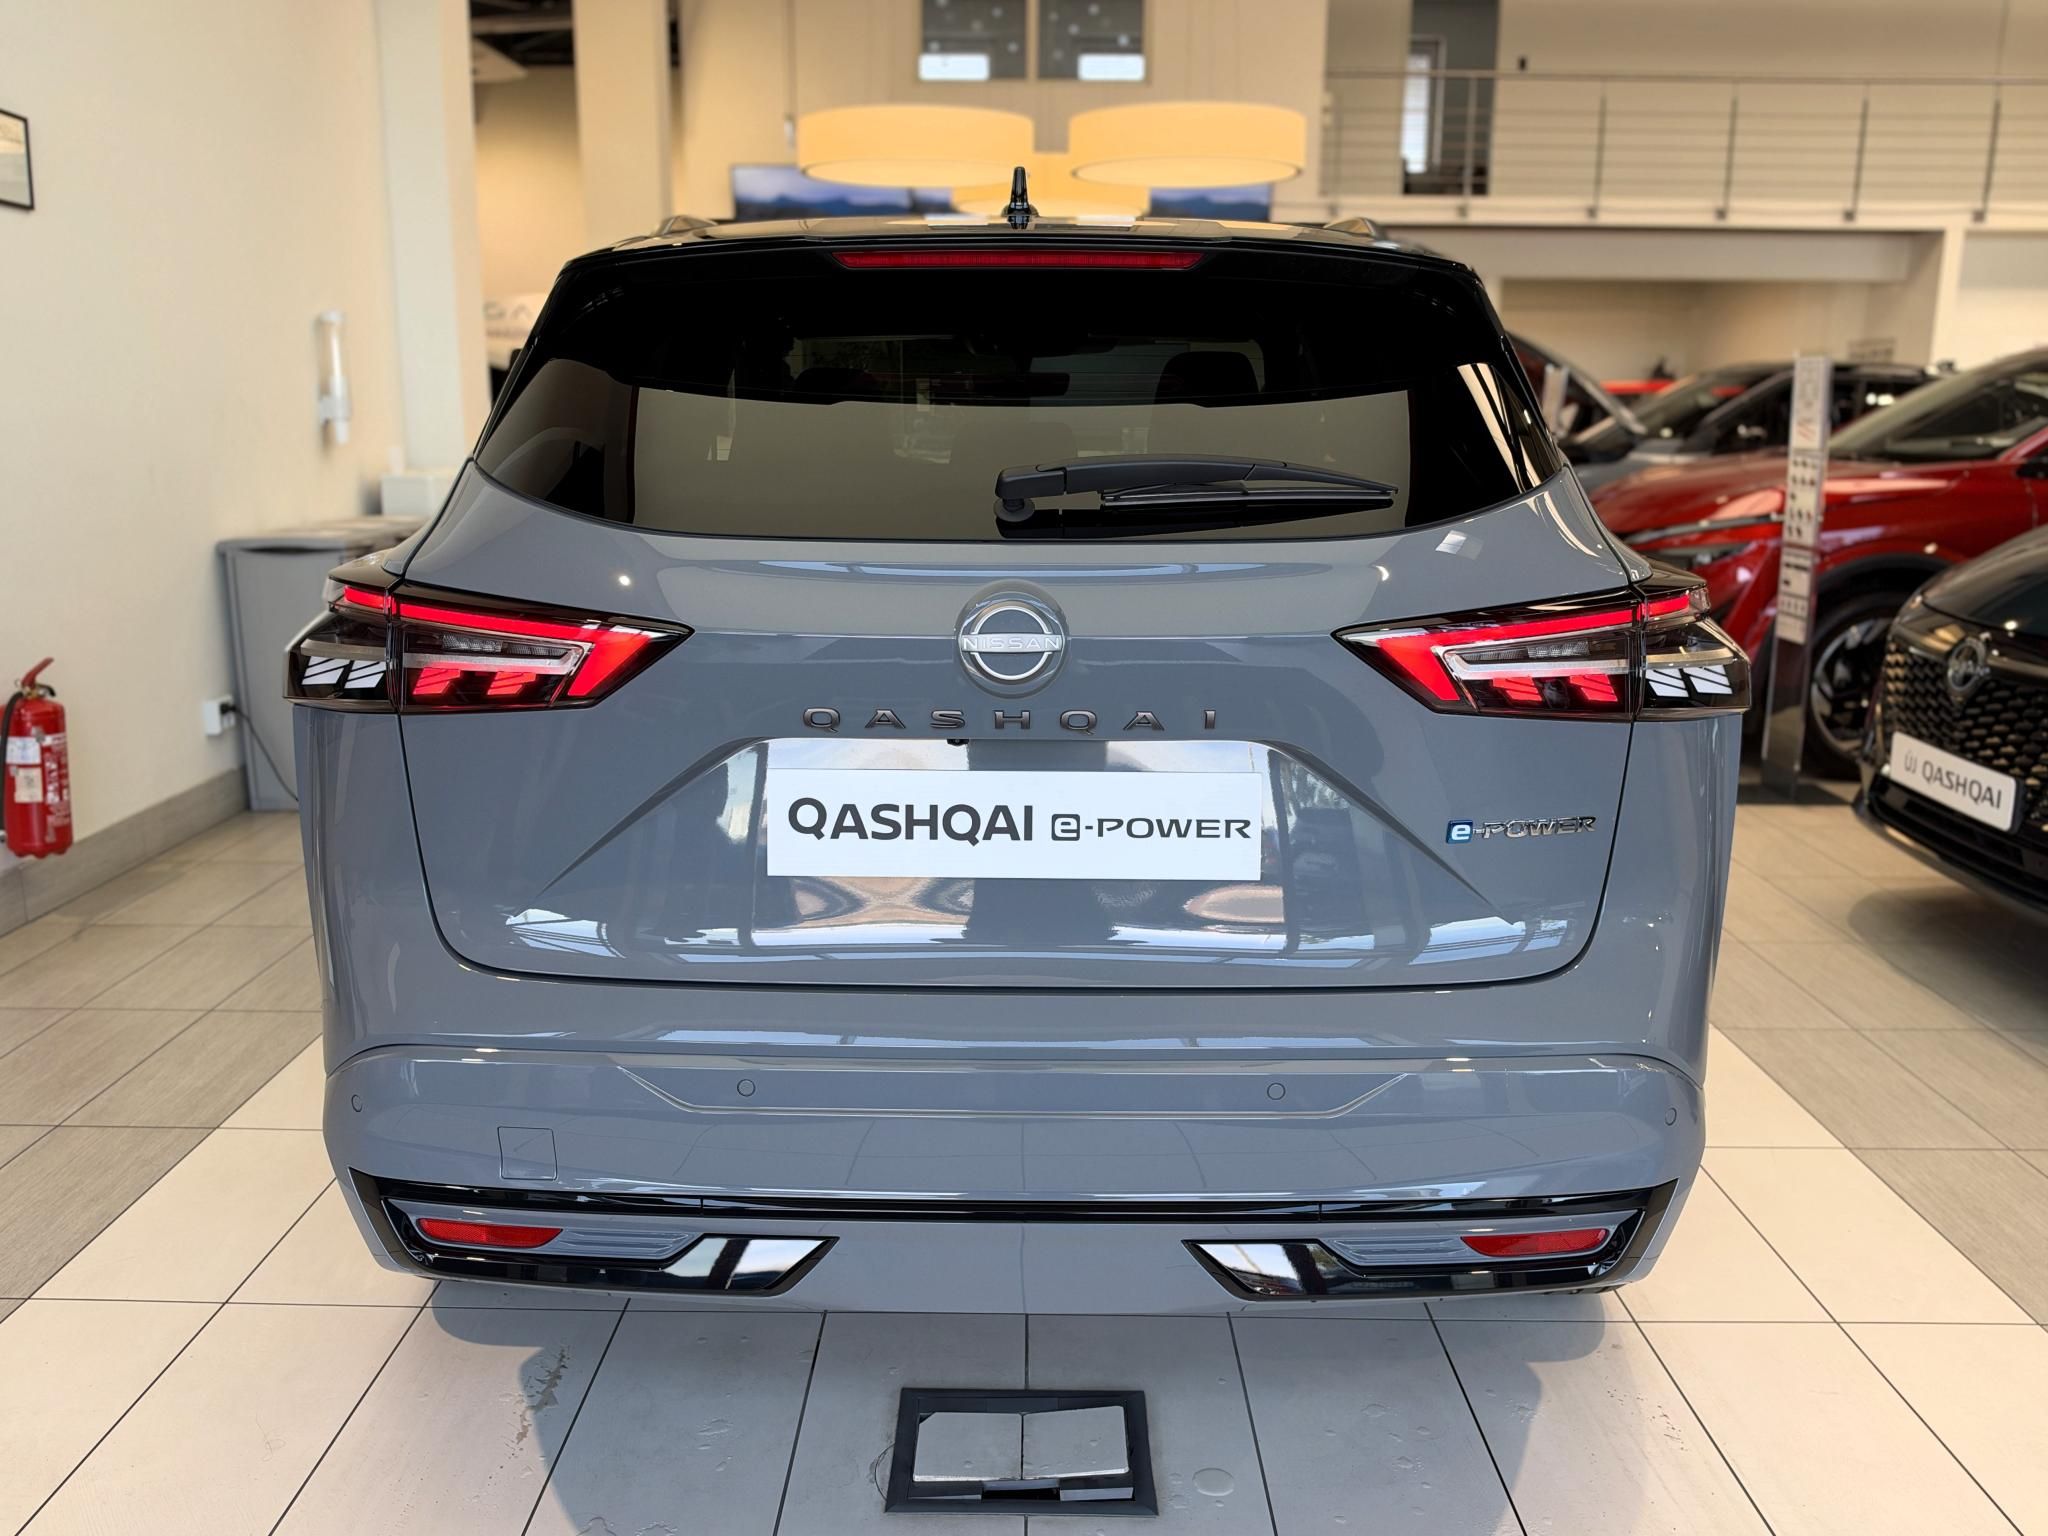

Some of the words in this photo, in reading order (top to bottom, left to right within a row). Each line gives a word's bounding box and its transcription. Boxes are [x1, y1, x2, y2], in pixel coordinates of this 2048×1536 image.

[962, 637, 1060, 650] NISSAN
[803, 707, 1217, 734] QASHQAI
[1922, 760, 2002, 809] QASHQAI
[788, 797, 1033, 846] QASHQAI
[1051, 813, 1252, 842] e-POWER
[1446, 816, 1597, 844] e-POWER
